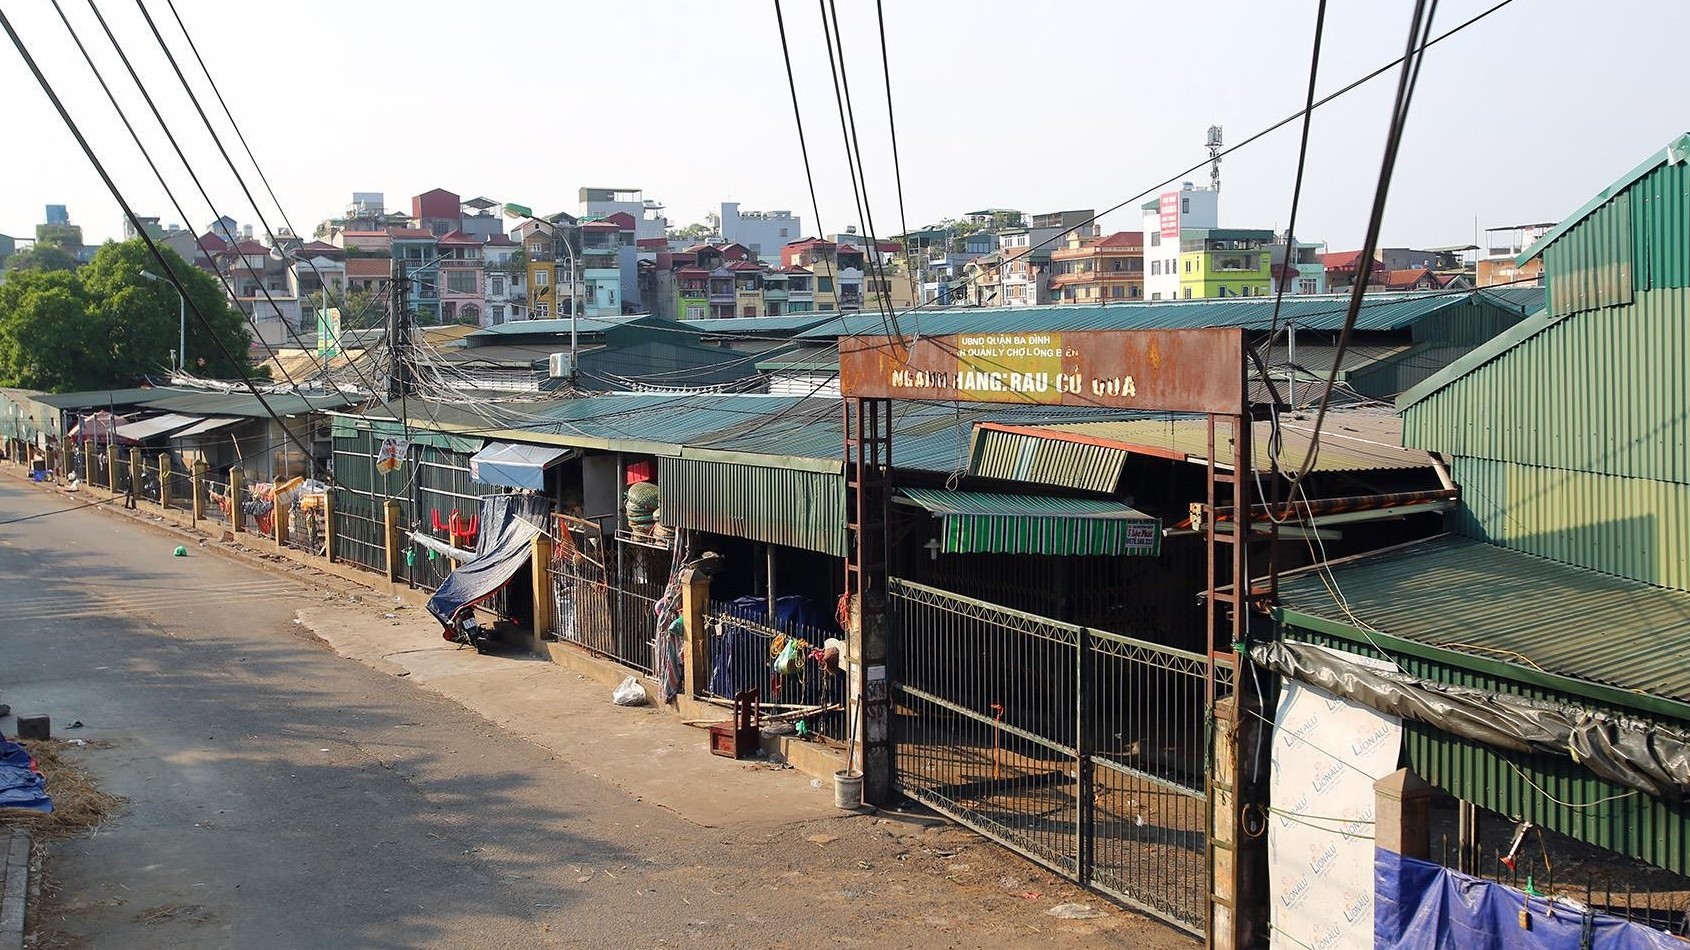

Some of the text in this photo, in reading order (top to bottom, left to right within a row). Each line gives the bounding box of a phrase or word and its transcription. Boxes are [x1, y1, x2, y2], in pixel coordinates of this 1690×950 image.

[962, 337, 985, 346] UBND
[1013, 336, 1027, 345] BA
[1010, 372, 1048, 392] RAU
[1351, 724, 1390, 757] LIONALU
[1312, 762, 1344, 793] LIONALU
[1309, 844, 1337, 875] LIONALU
[1280, 878, 1309, 907] LIONALU
[1343, 893, 1370, 923] LIONALU
